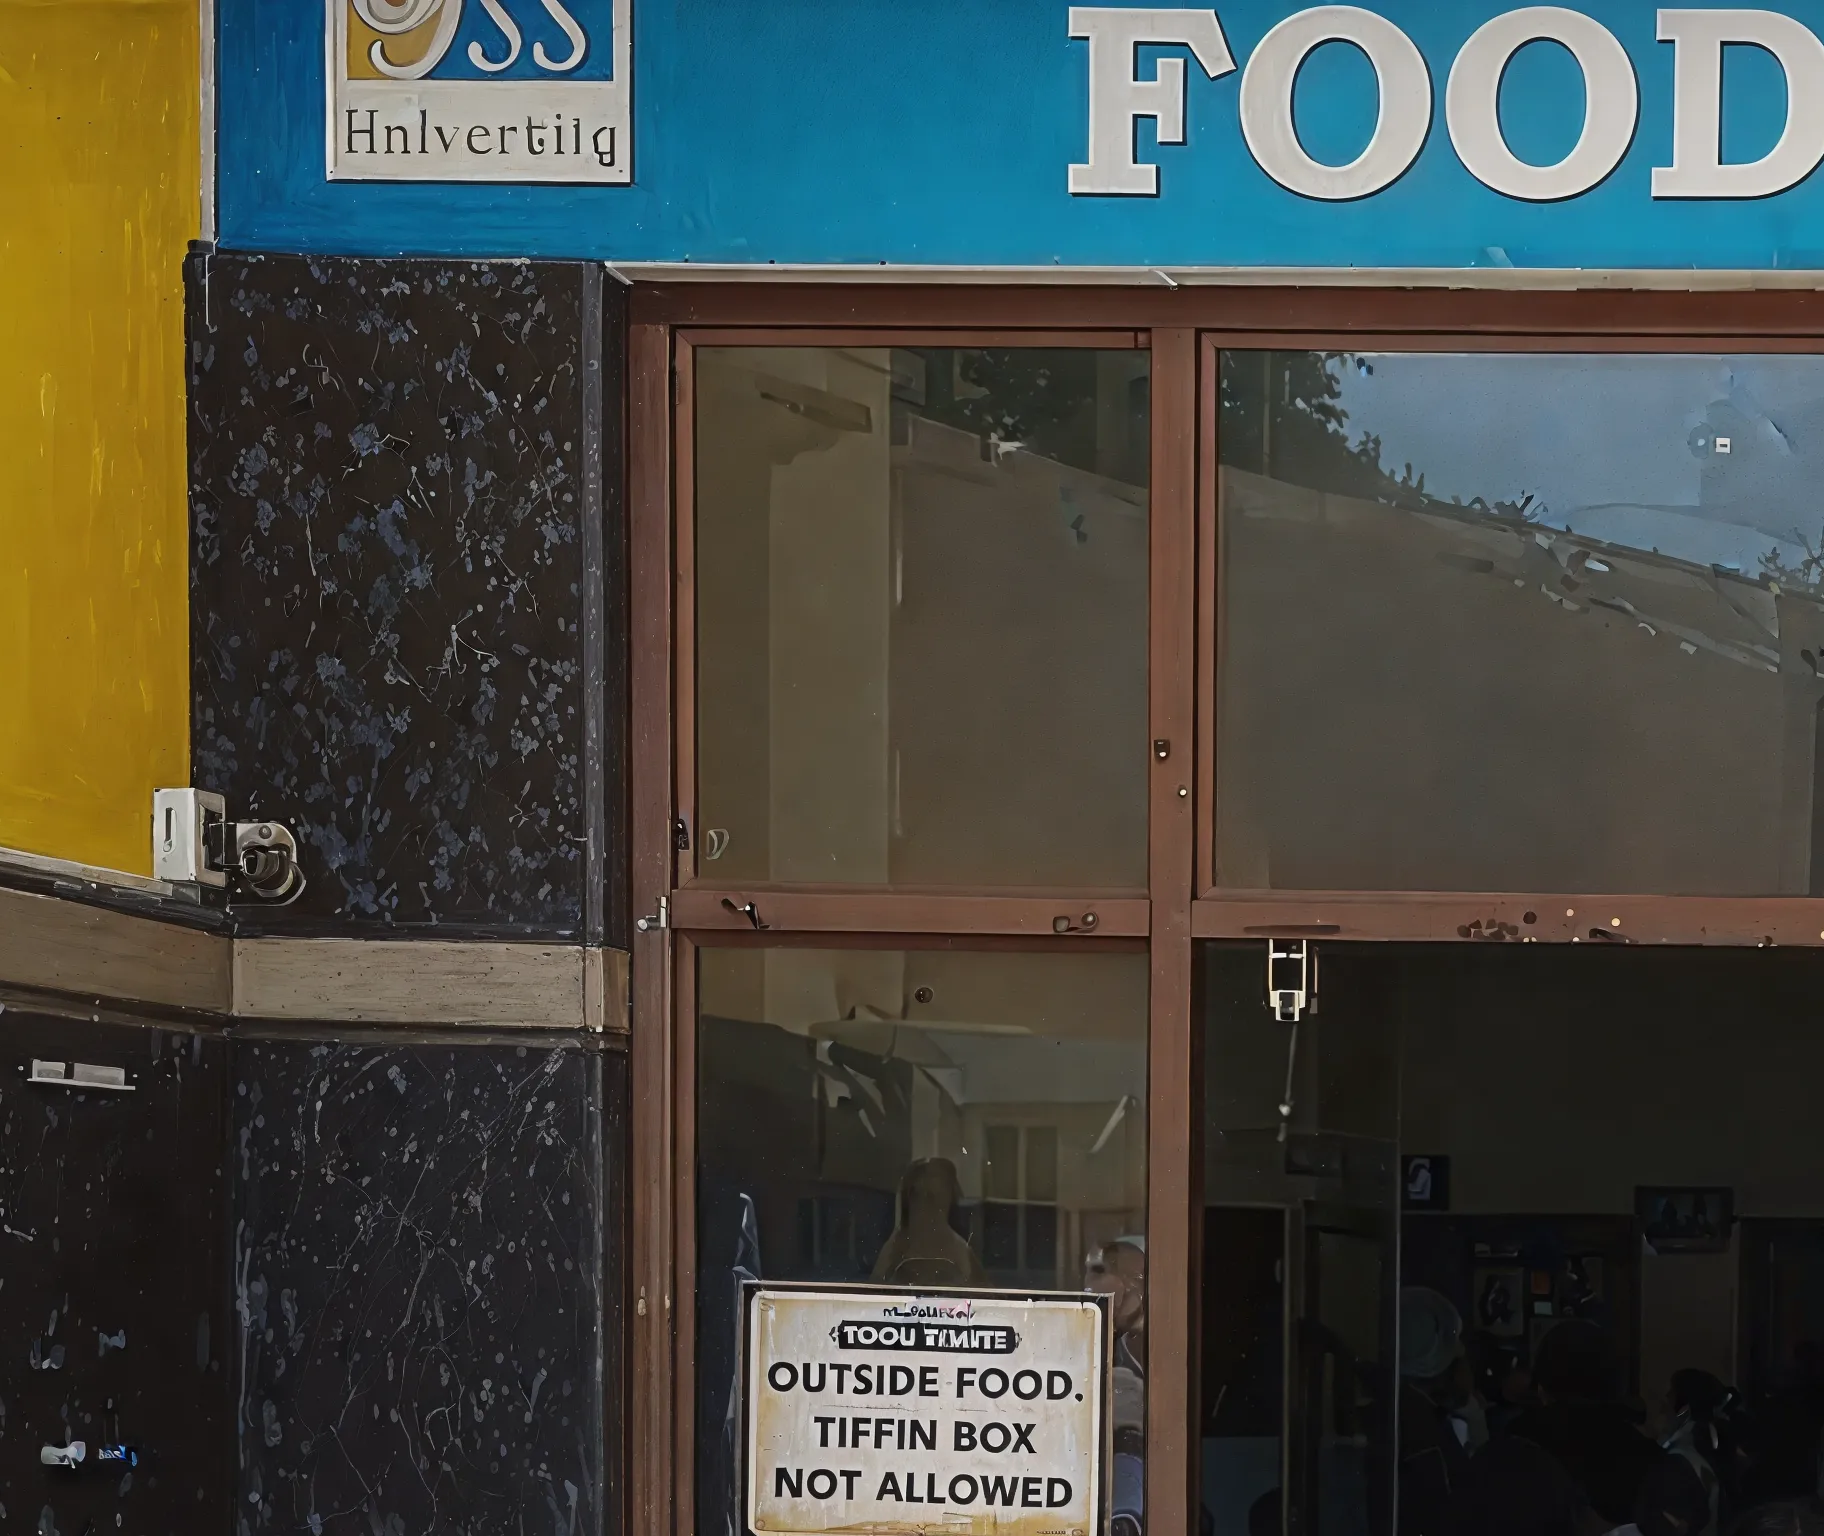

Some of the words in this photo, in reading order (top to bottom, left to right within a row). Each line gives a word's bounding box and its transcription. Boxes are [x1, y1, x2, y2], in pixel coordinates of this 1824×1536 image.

[767, 1360, 940, 1398] OUTSIDE
[813, 1415, 938, 1451] TIFFIN
[953, 1420, 1037, 1454] BOX
[774, 1466, 863, 1501] NOT
[875, 1470, 1074, 1509] ALLOWED
